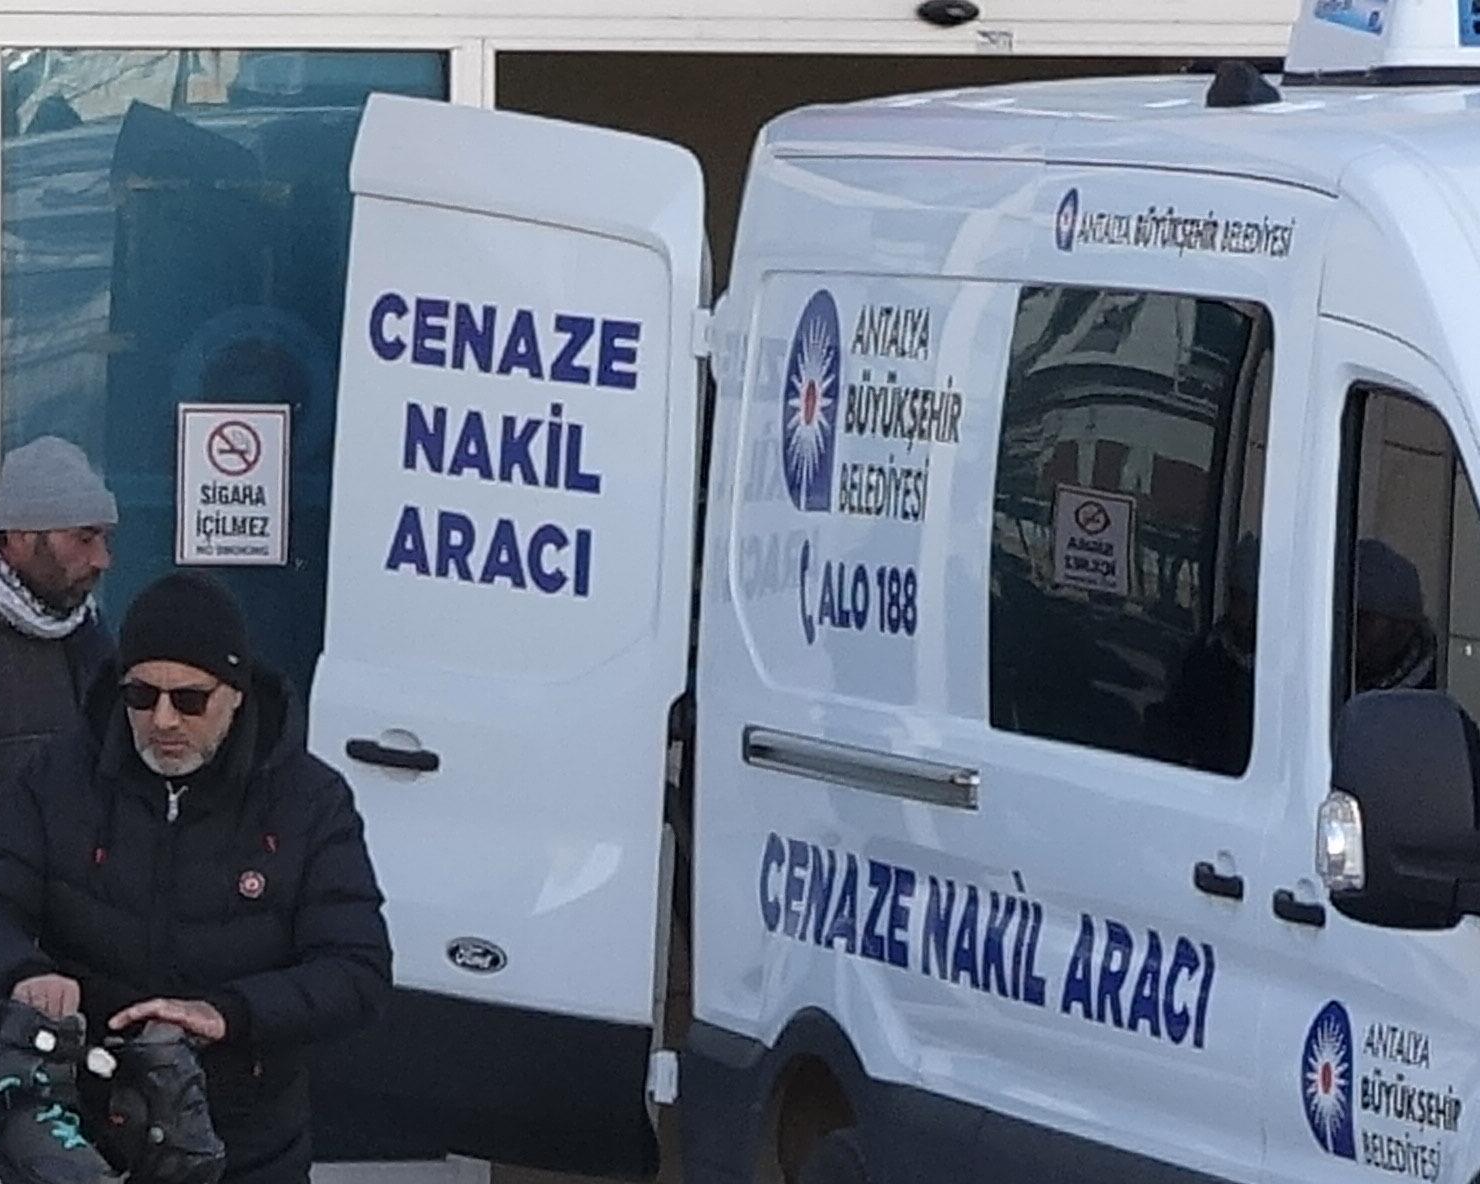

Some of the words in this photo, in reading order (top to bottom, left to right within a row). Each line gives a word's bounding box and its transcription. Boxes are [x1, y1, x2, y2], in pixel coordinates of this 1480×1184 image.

[368, 292, 642, 390] CENAZE
[851, 304, 931, 361] ANTALYA
[844, 368, 962, 455] BÜYÜKŞEHİR
[403, 402, 601, 495] NAKİL
[200, 480, 267, 506] SİGARA
[838, 452, 930, 523] BELEDİYESİ
[196, 509, 271, 544] İÇİLMEZ
[385, 504, 593, 598] ARACI
[819, 560, 870, 631] ALO
[876, 566, 918, 636] 188
[759, 831, 916, 970] CENAZE
[922, 869, 1046, 1006] NAKİL
[1060, 913, 1216, 1049] ARACI
[1362, 1021, 1430, 1070] ANTALYA
[1360, 1067, 1462, 1133] BÜYÜKŞEHİR
[1361, 1127, 1442, 1184] BELEDİYESİ
